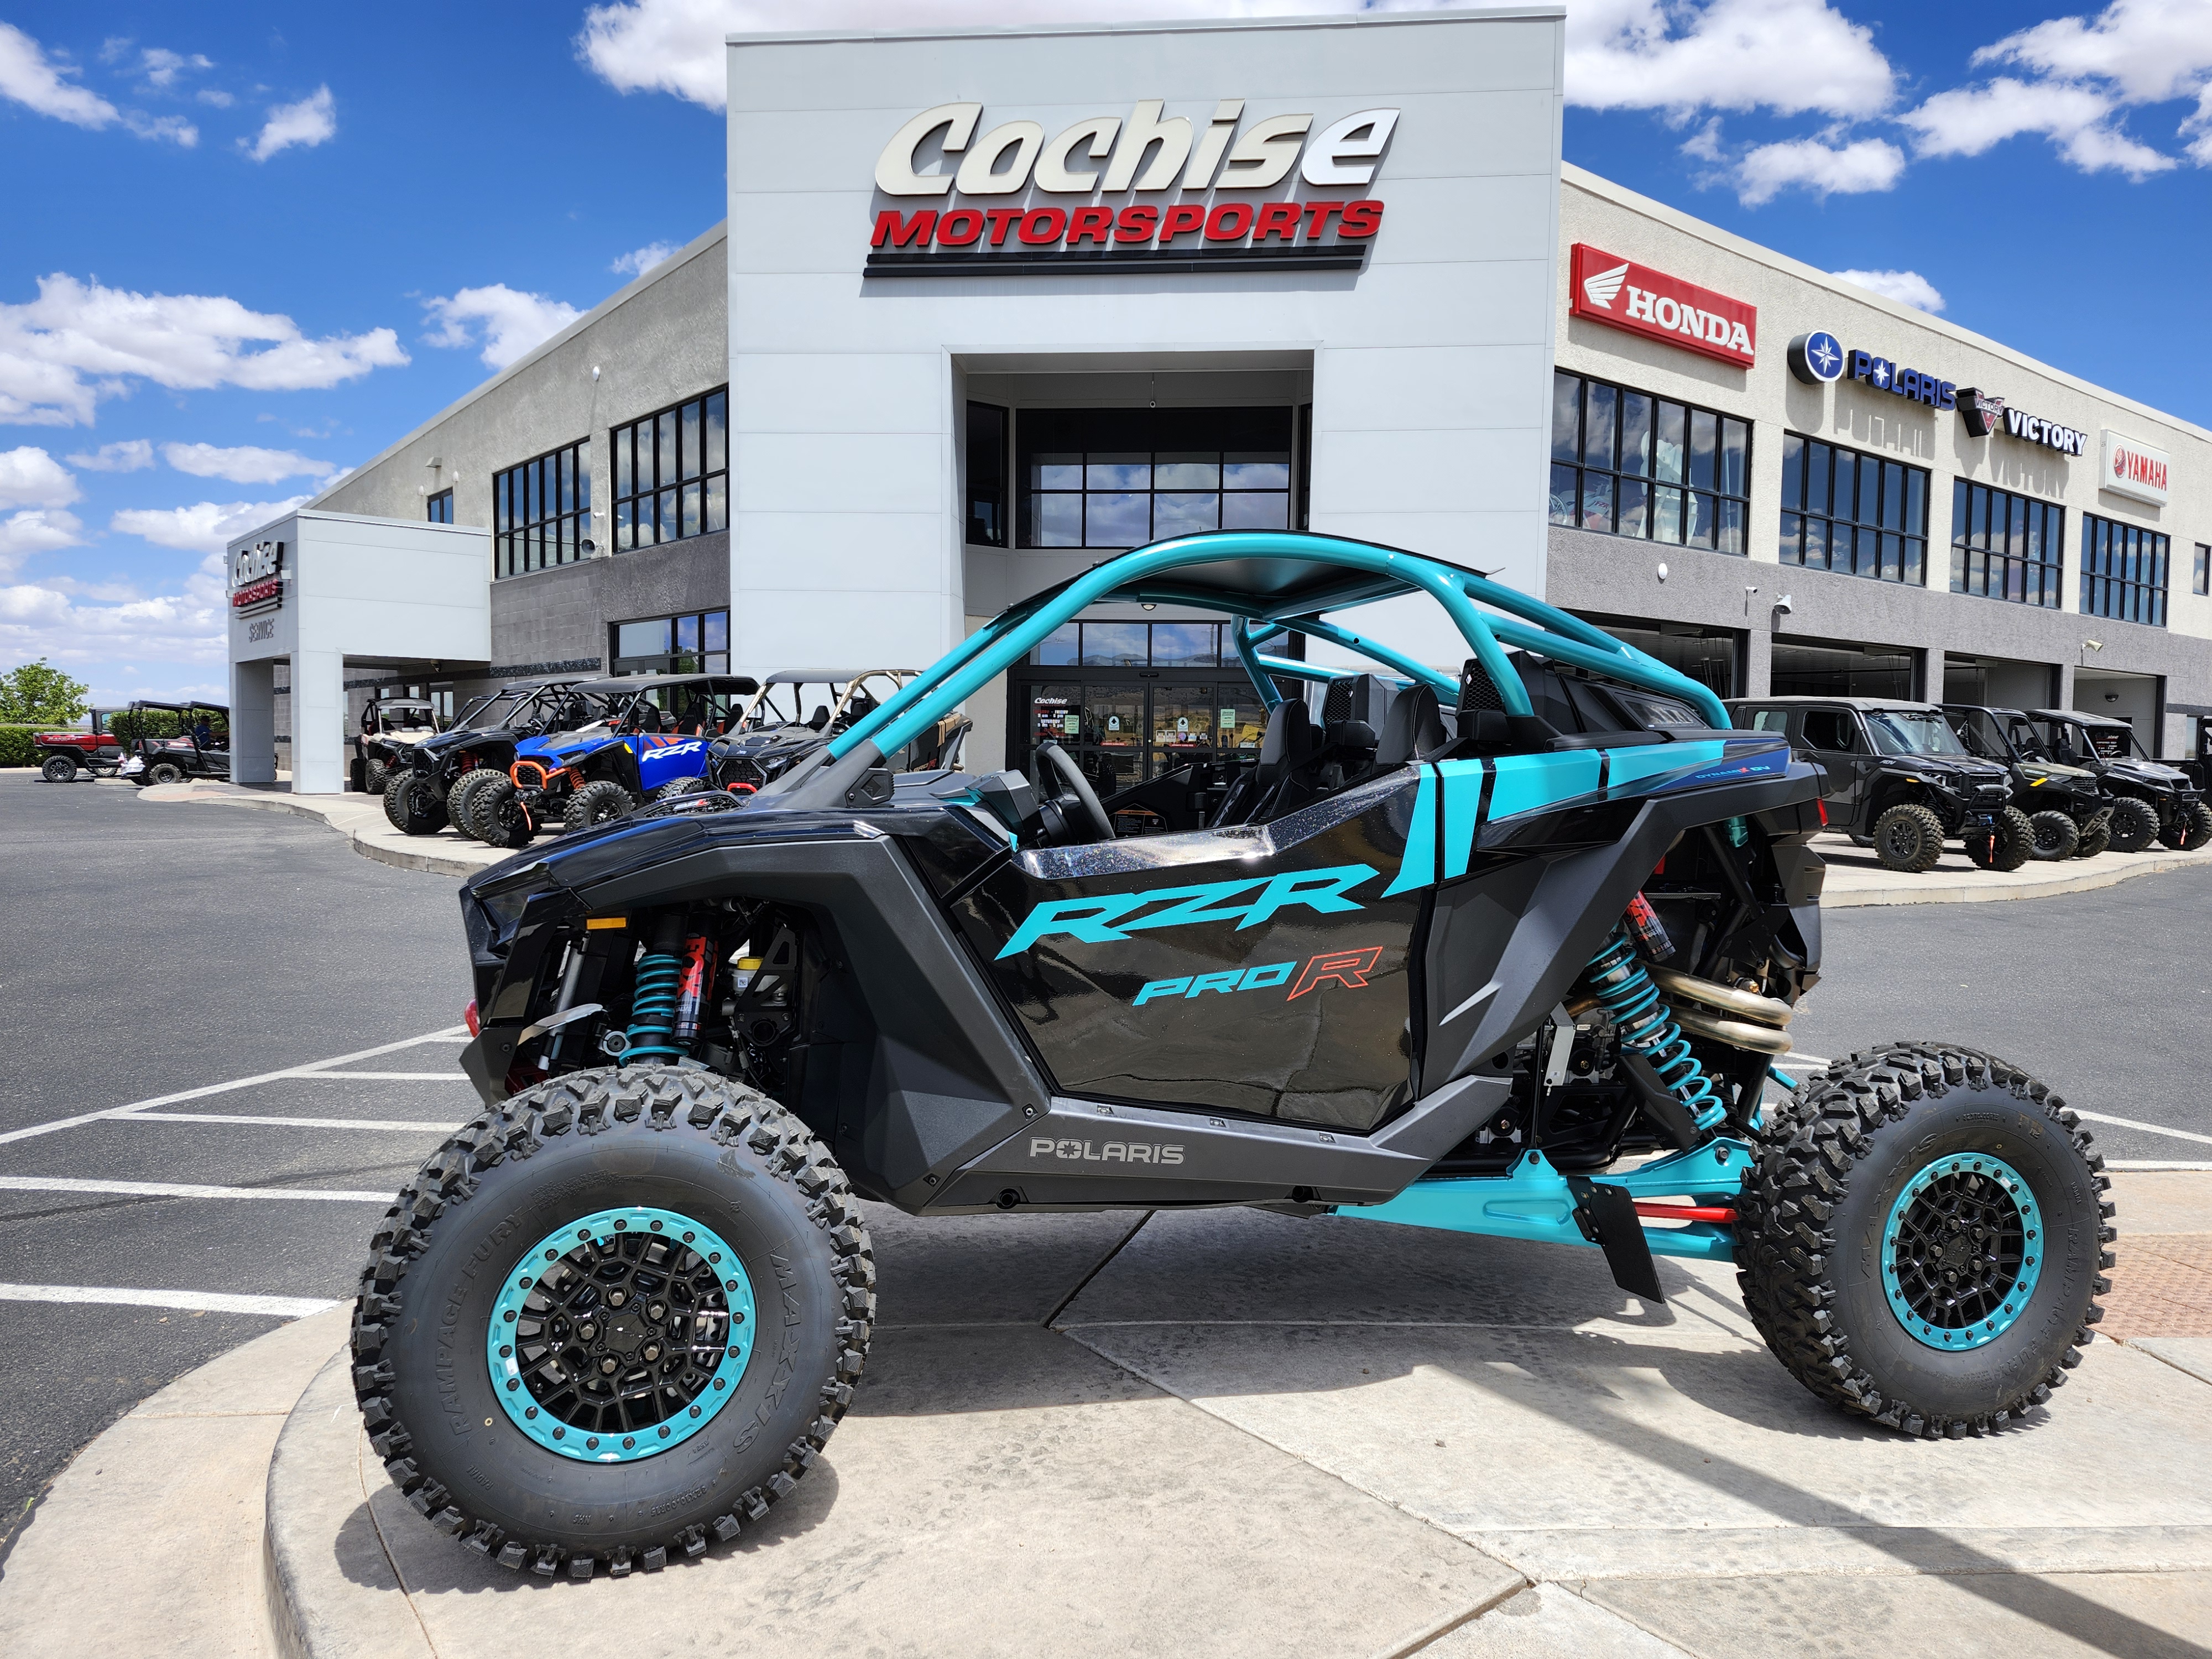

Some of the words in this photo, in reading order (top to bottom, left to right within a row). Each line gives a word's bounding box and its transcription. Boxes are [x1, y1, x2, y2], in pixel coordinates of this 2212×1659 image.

[875, 98, 1401, 195] Cochise
[870, 199, 1385, 247] MOTORSPORTS
[1626, 285, 1754, 356] HONDA
[1848, 349, 1957, 411] POLARIS
[1975, 399, 2004, 414] VICTORY
[2005, 408, 2088, 456] VICTORY
[2127, 451, 2167, 492] YAMAHA
[232, 540, 282, 588] Cochise
[233, 578, 281, 607] MOTORSPORTS
[249, 618, 275, 643] SERVICE
[642, 741, 702, 762] RZR
[914, 762, 929, 772] PRO
[1695, 767, 1750, 779] DYNAMIX
[994, 863, 1380, 961] RZR
[1131, 961, 1298, 1006] PRO
[1286, 946, 1384, 1002] R
[1029, 1136, 1186, 1165] POLARIS
[2070, 1181, 2083, 1206] RADIAL
[2040, 1227, 2080, 1340] RAMPAGE
[436, 1284, 472, 1436] RAMPAGE
[462, 1206, 525, 1280] FURY
[733, 1253, 801, 1454] MAXXIS
[1999, 1336, 2038, 1380] FURY
[466, 1465, 494, 1491] RADIAL
[573, 1512, 592, 1526] NHS
